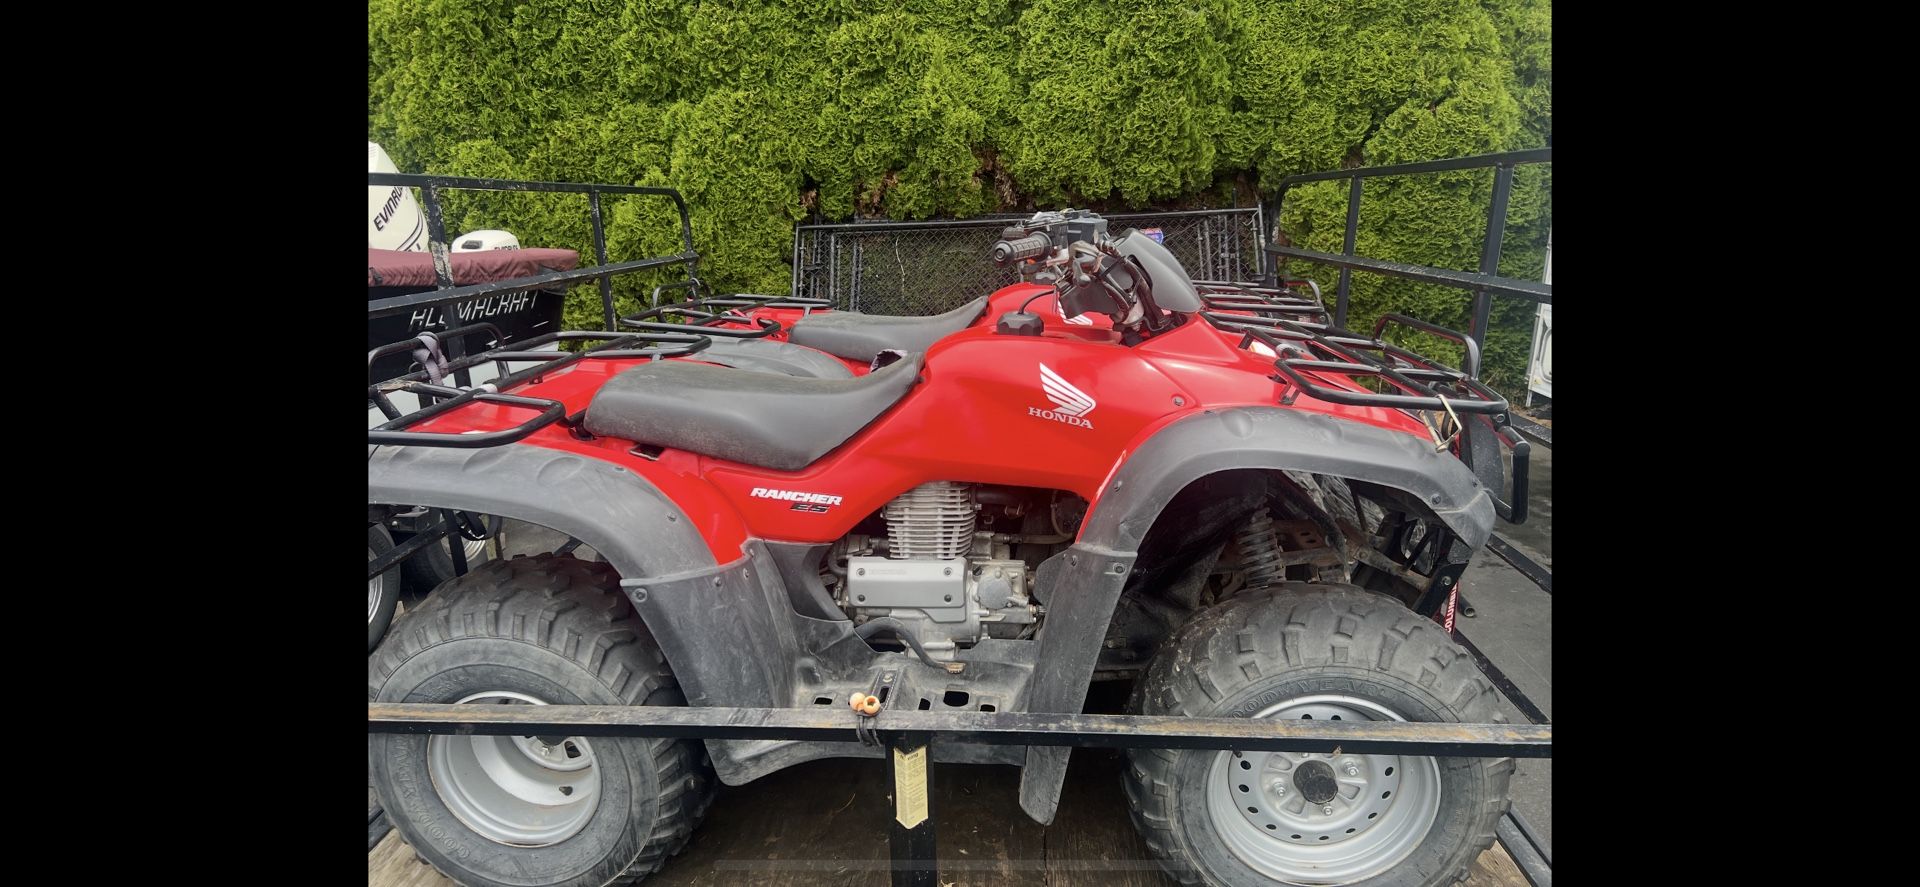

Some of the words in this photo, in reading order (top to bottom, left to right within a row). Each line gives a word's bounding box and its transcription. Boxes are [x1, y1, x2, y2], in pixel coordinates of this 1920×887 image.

[373, 186, 404, 231] EVINRU
[1028, 406, 1094, 429] HONDA
[750, 487, 842, 505] RANCHER
[791, 503, 830, 513] ES
